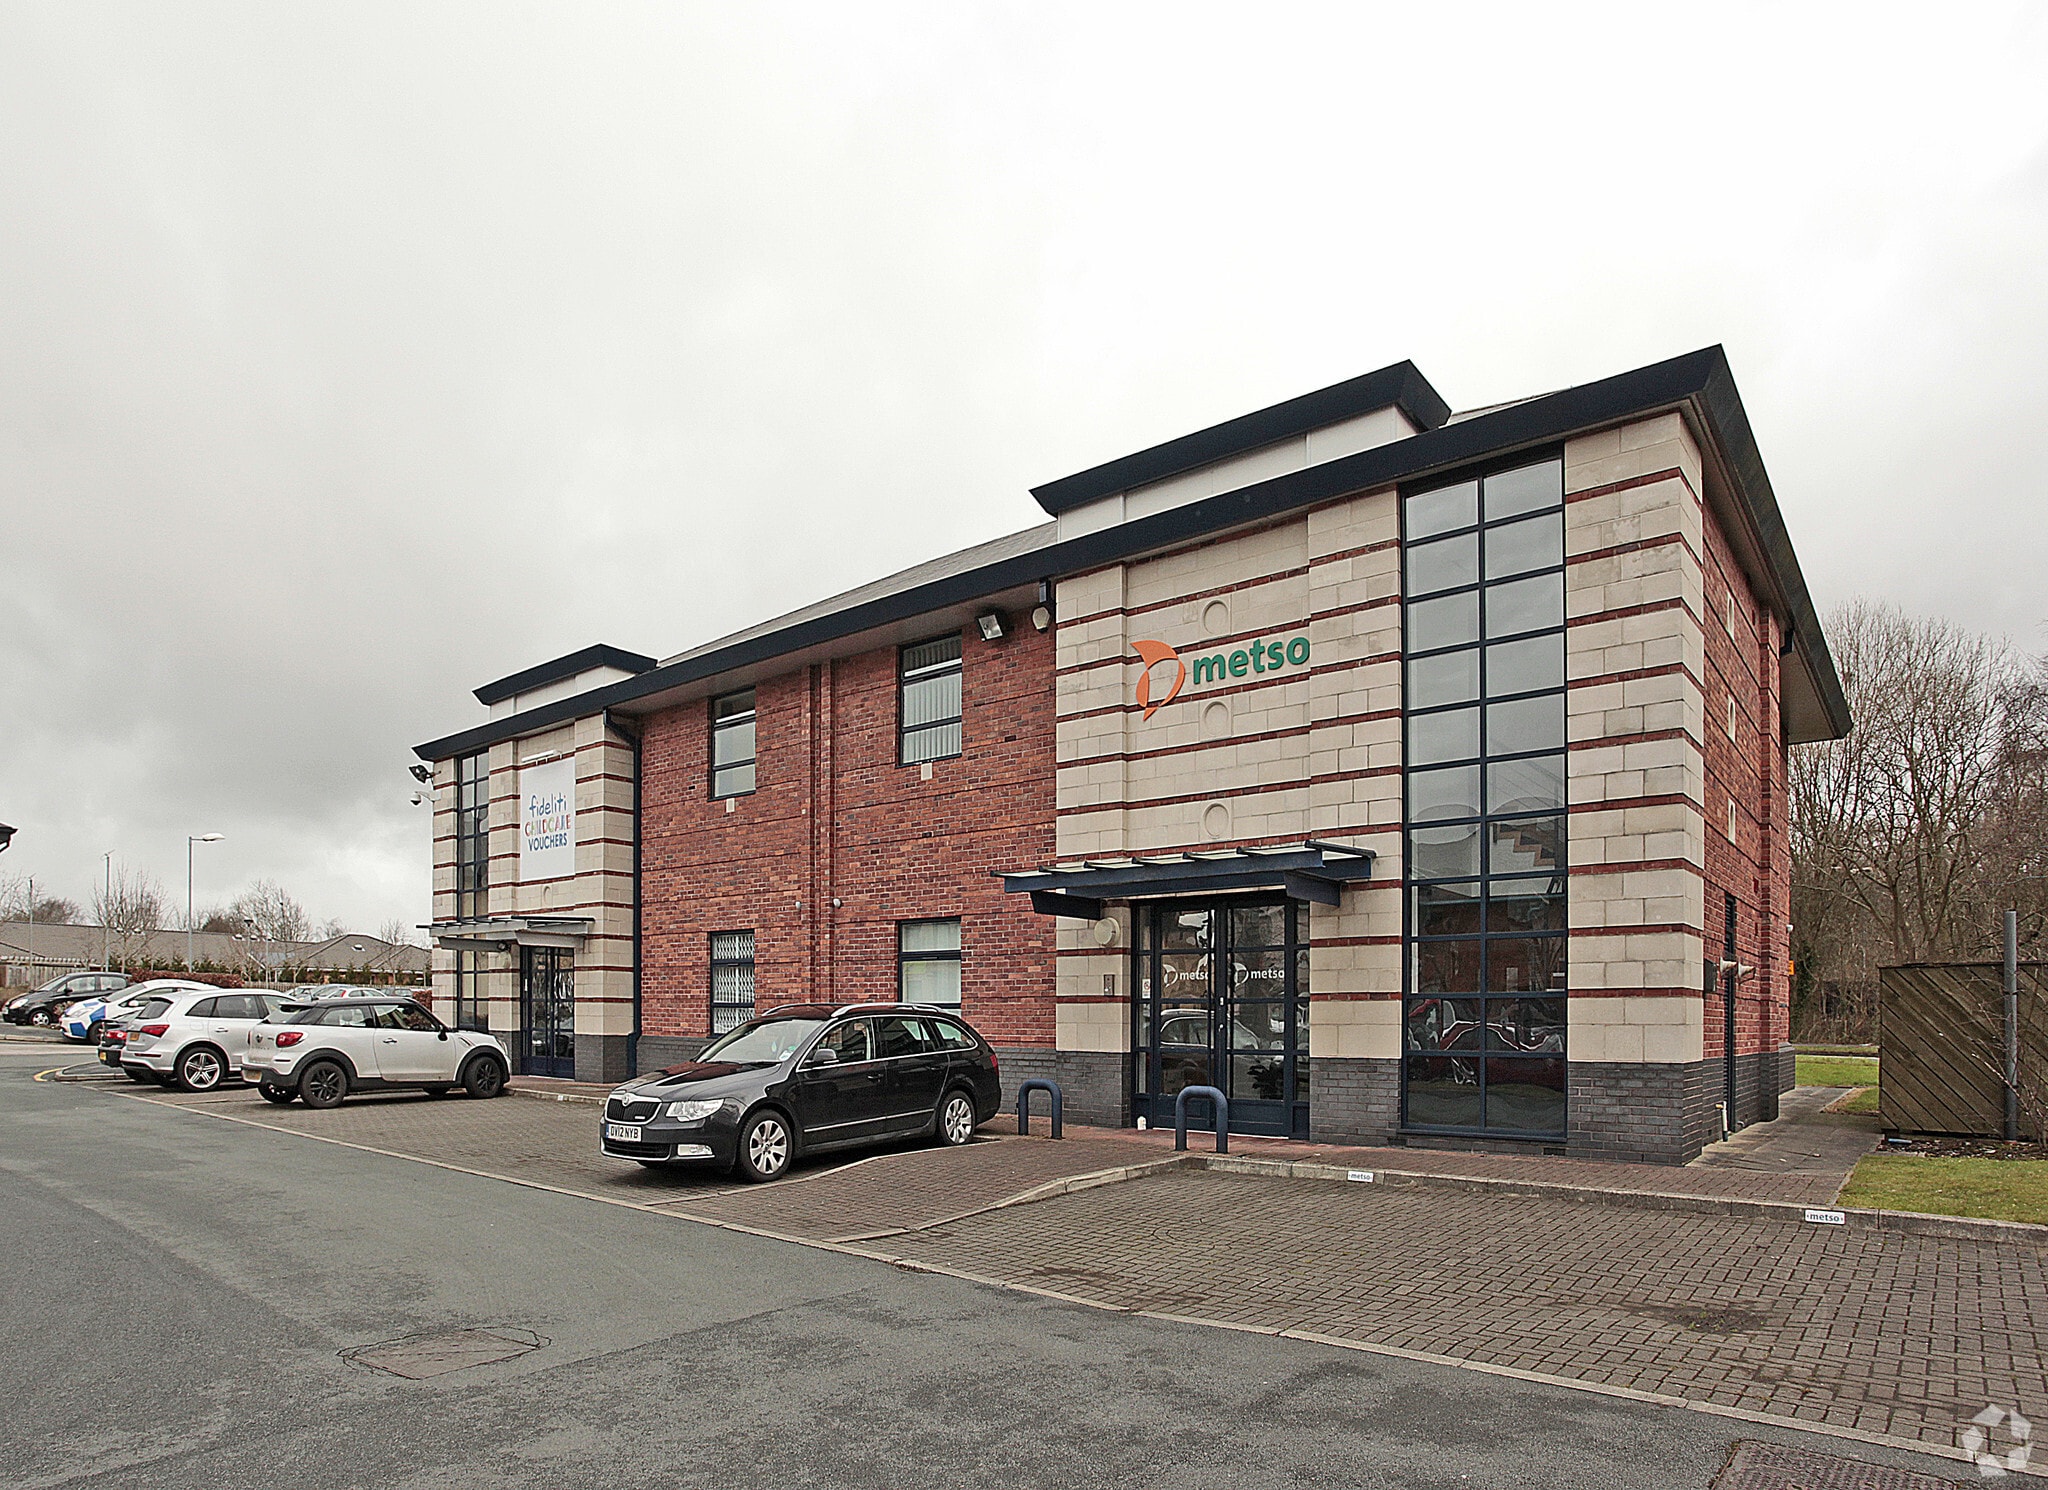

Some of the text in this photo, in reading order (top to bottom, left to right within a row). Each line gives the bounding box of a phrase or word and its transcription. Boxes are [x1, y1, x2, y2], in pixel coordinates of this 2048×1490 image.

[1193, 636, 1311, 685] metso
[529, 792, 567, 817] fideliti
[525, 814, 571, 837] CHILDCARE
[528, 832, 568, 852] VOUCHERS
[1250, 969, 1284, 979] metso
[1810, 1213, 1840, 1222] metso
